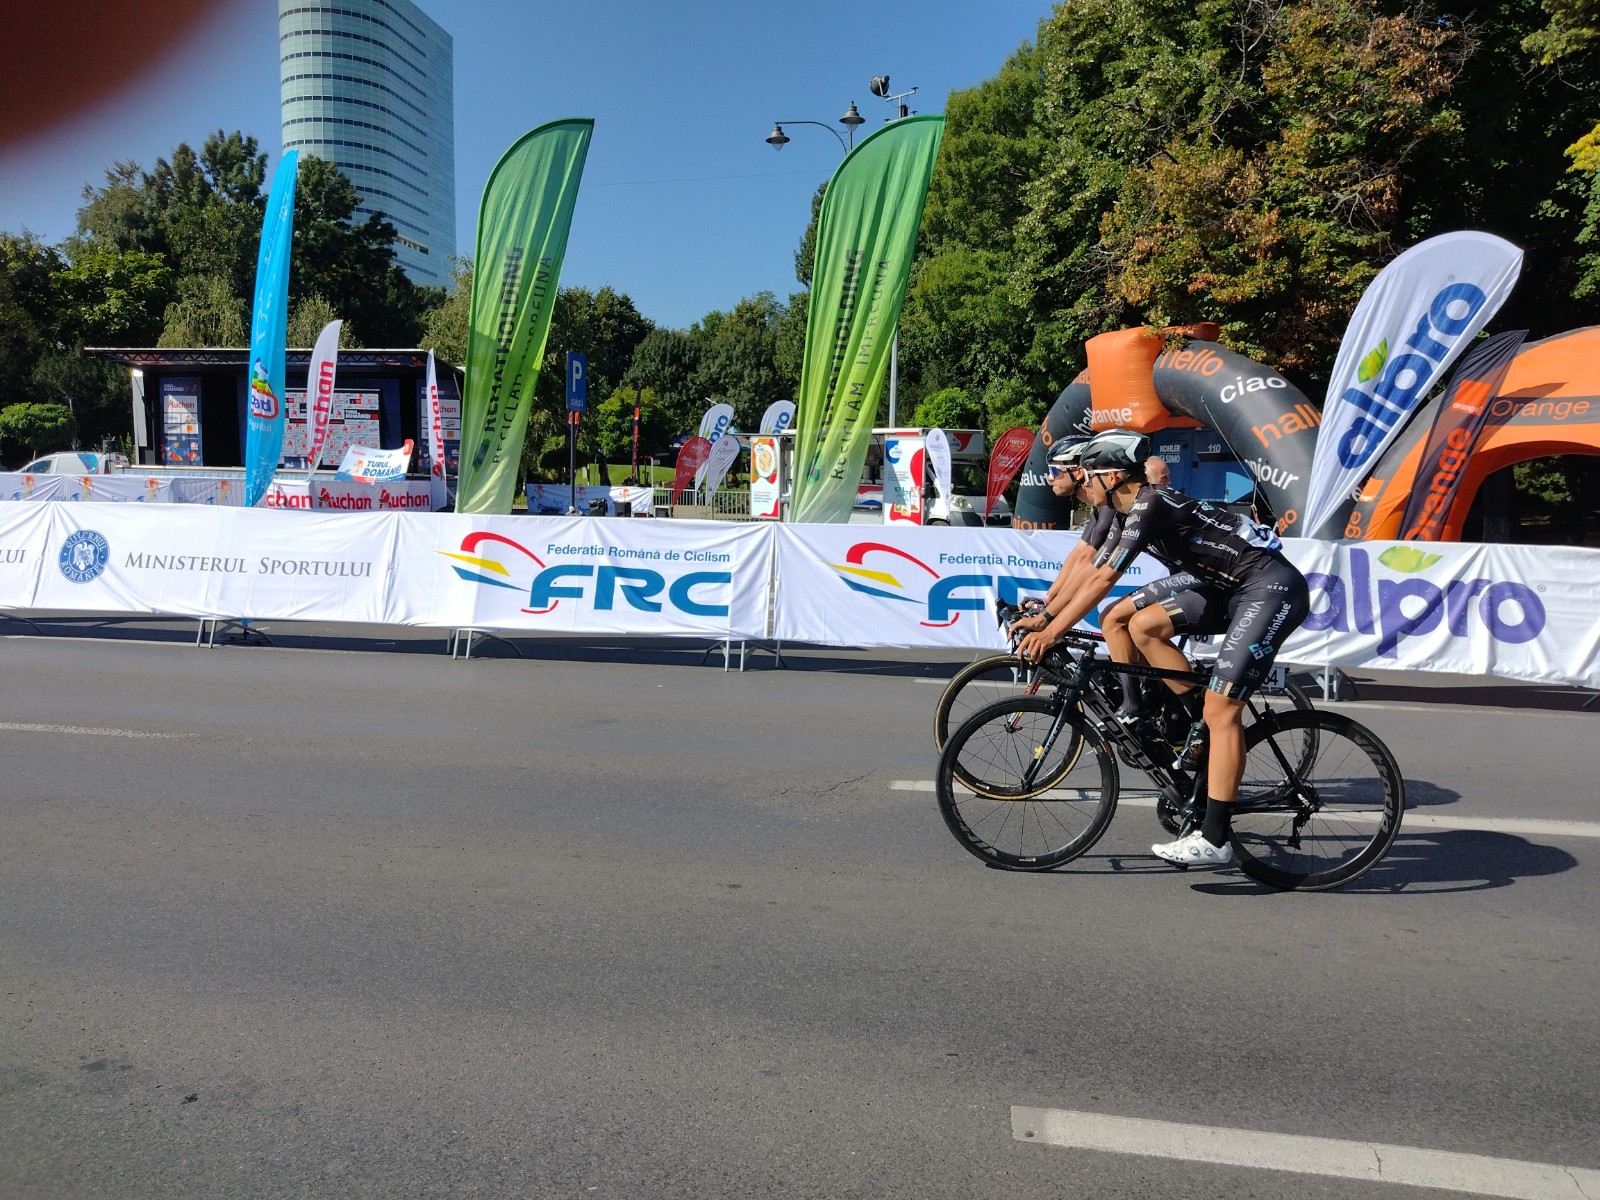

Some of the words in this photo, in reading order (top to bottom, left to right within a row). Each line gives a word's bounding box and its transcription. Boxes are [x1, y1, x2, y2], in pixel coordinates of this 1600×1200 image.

[572, 360, 583, 393] P
[1159, 348, 1224, 377] hello
[1337, 282, 1487, 470] alpro
[1220, 376, 1287, 404] ciao
[1092, 406, 1133, 426] range
[1452, 401, 1481, 414] orange
[1491, 399, 1590, 421] Orange
[709, 415, 729, 444] pro
[1251, 404, 1322, 449] hall
[1159, 444, 1181, 452] KOHLER
[318, 488, 372, 510] Auchan
[378, 489, 430, 509] Auchan
[66, 531, 107, 552] GUVERNUL
[608, 546, 661, 560] Română
[664, 549, 680, 561] de
[683, 550, 731, 563] Ciclism
[125, 551, 248, 574] MINISTERUL
[258, 556, 372, 578] SPORTULUI
[529, 564, 732, 616] FRC
[1299, 548, 1547, 659] alpro
[1223, 600, 1265, 651] VICTORIA
[1262, 603, 1292, 645] savinidue
